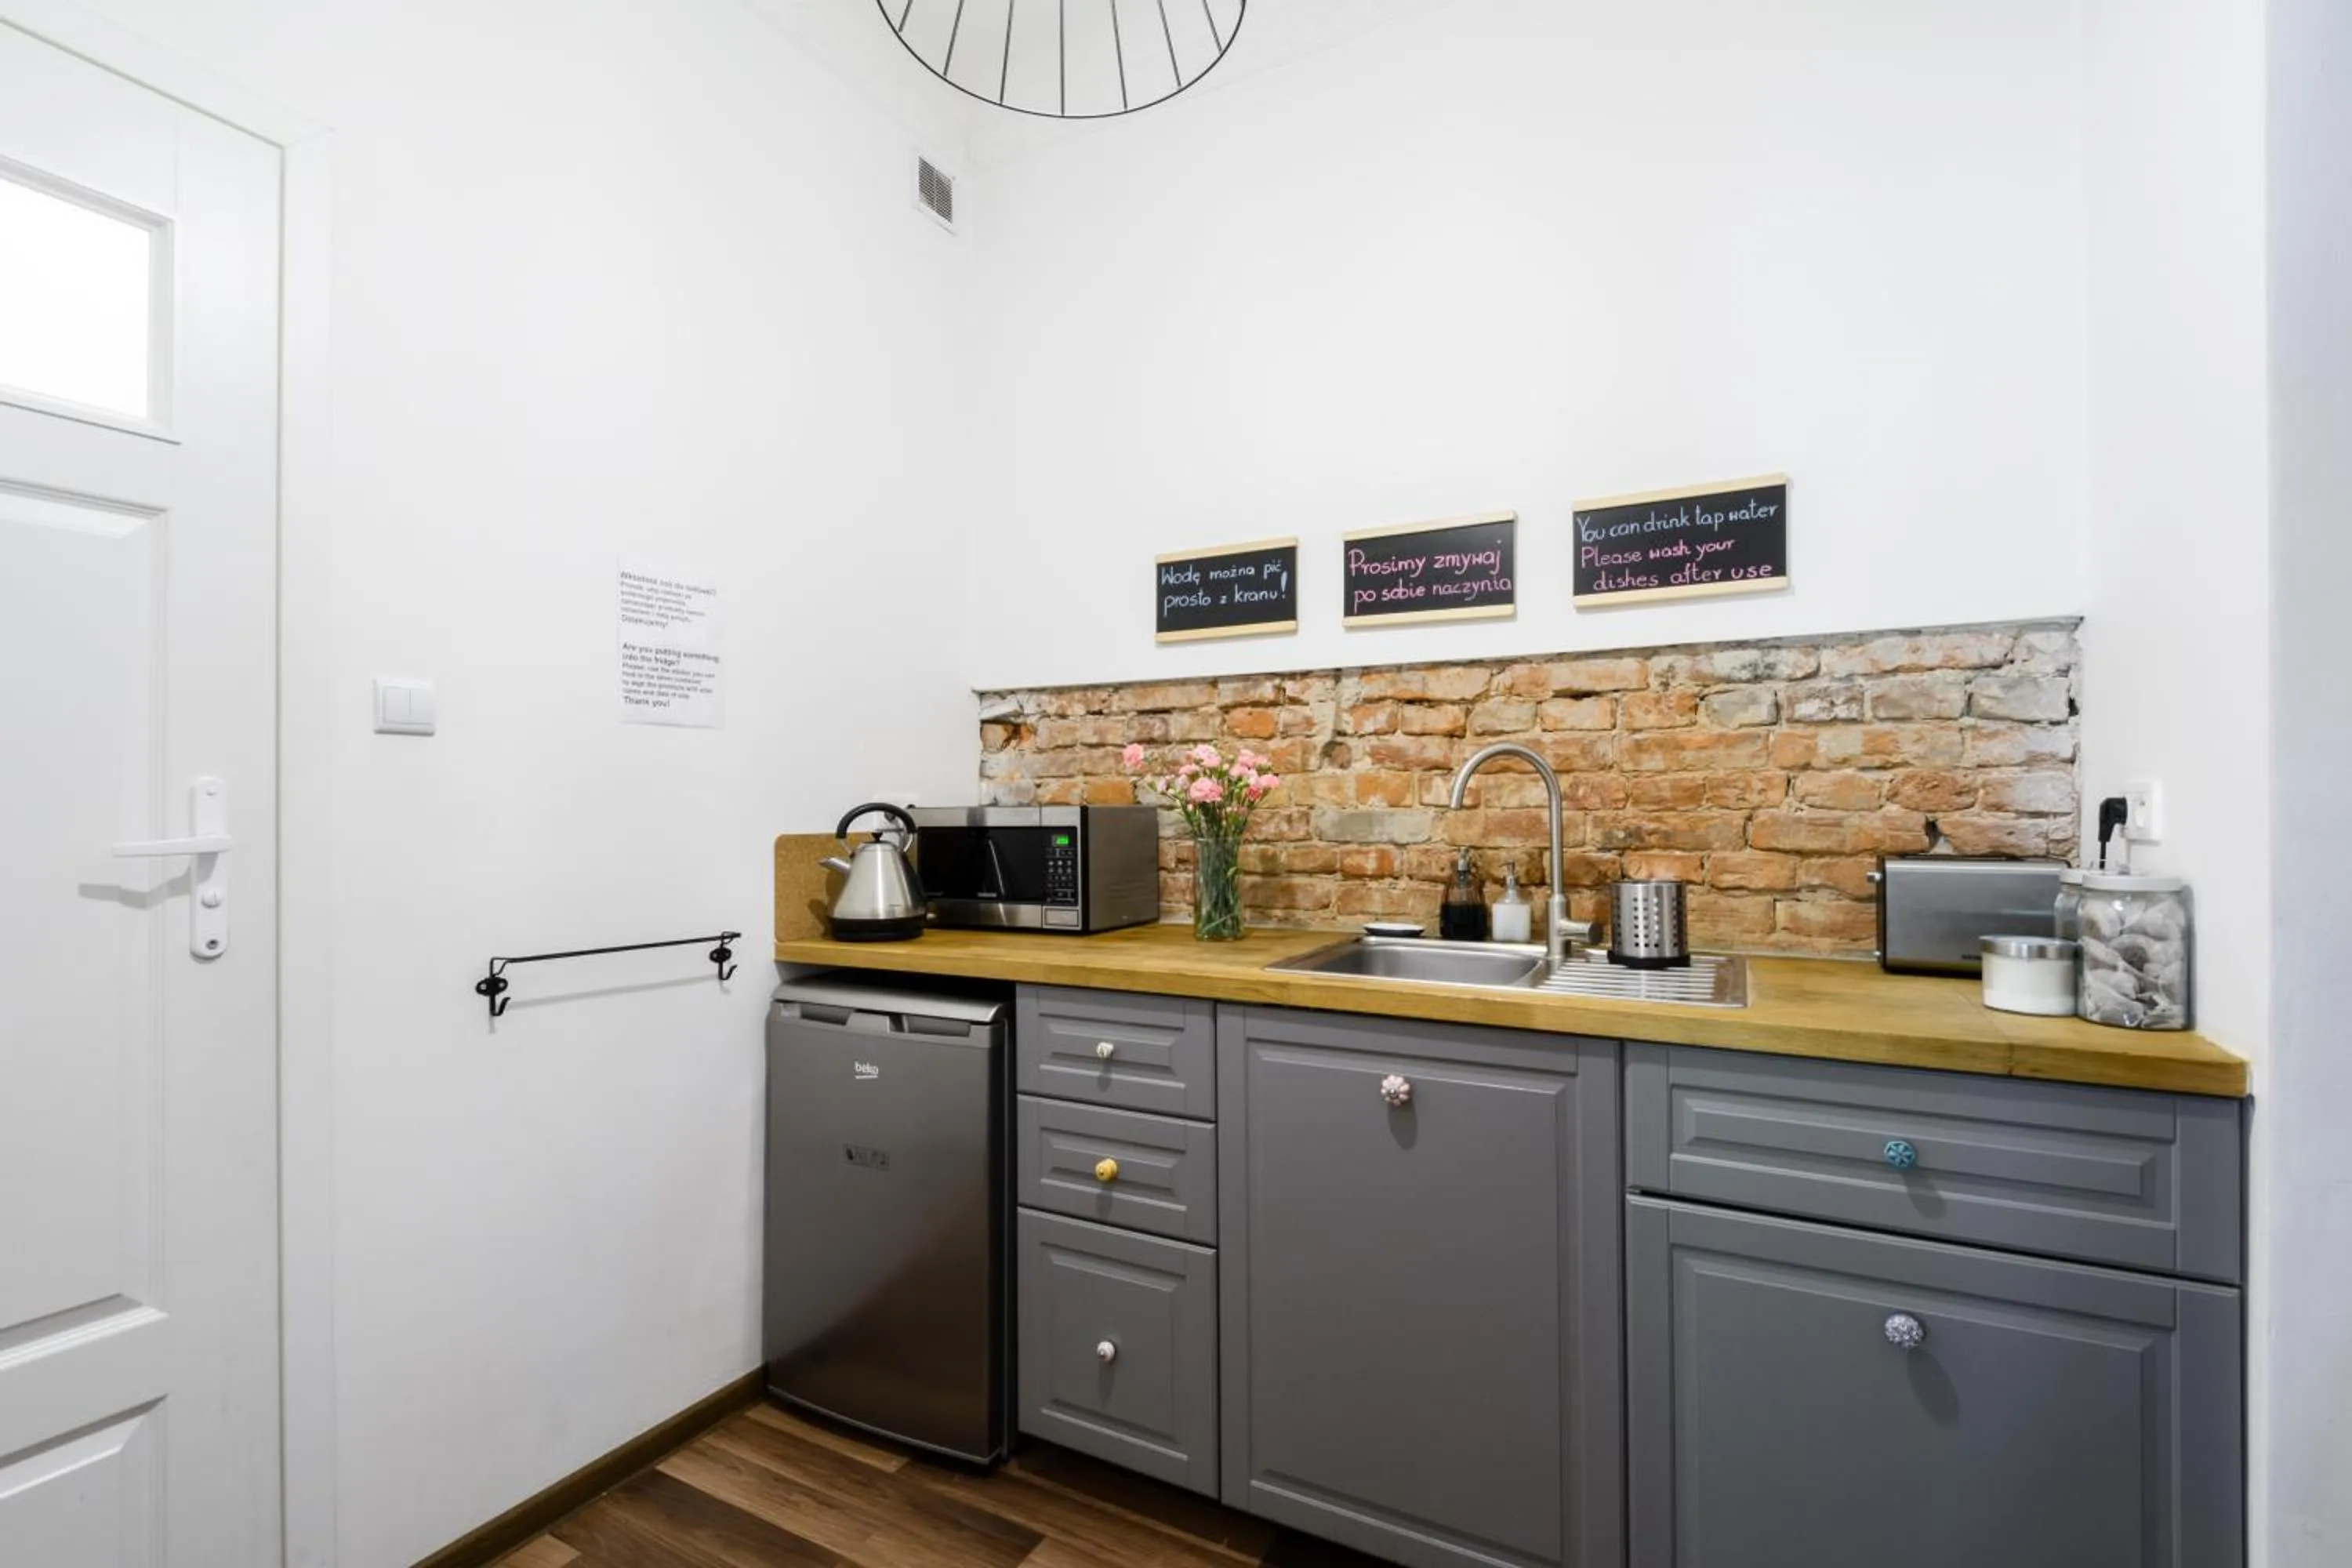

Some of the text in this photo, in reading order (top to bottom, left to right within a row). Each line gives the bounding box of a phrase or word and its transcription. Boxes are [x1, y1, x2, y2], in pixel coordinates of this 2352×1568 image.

[1577, 499, 1779, 543] You can drink tap water
[1348, 539, 1502, 578] Prosimy zmywaj
[1581, 539, 1735, 568] Please wash your
[1161, 564, 1201, 586] Wodę
[1210, 564, 1254, 581] można
[1593, 563, 1773, 591] dishes after use
[1163, 590, 1211, 618] prosto
[1219, 595, 1228, 604] z
[1354, 578, 1512, 614] po sobie naczynia
[855, 1061, 879, 1075] beko
